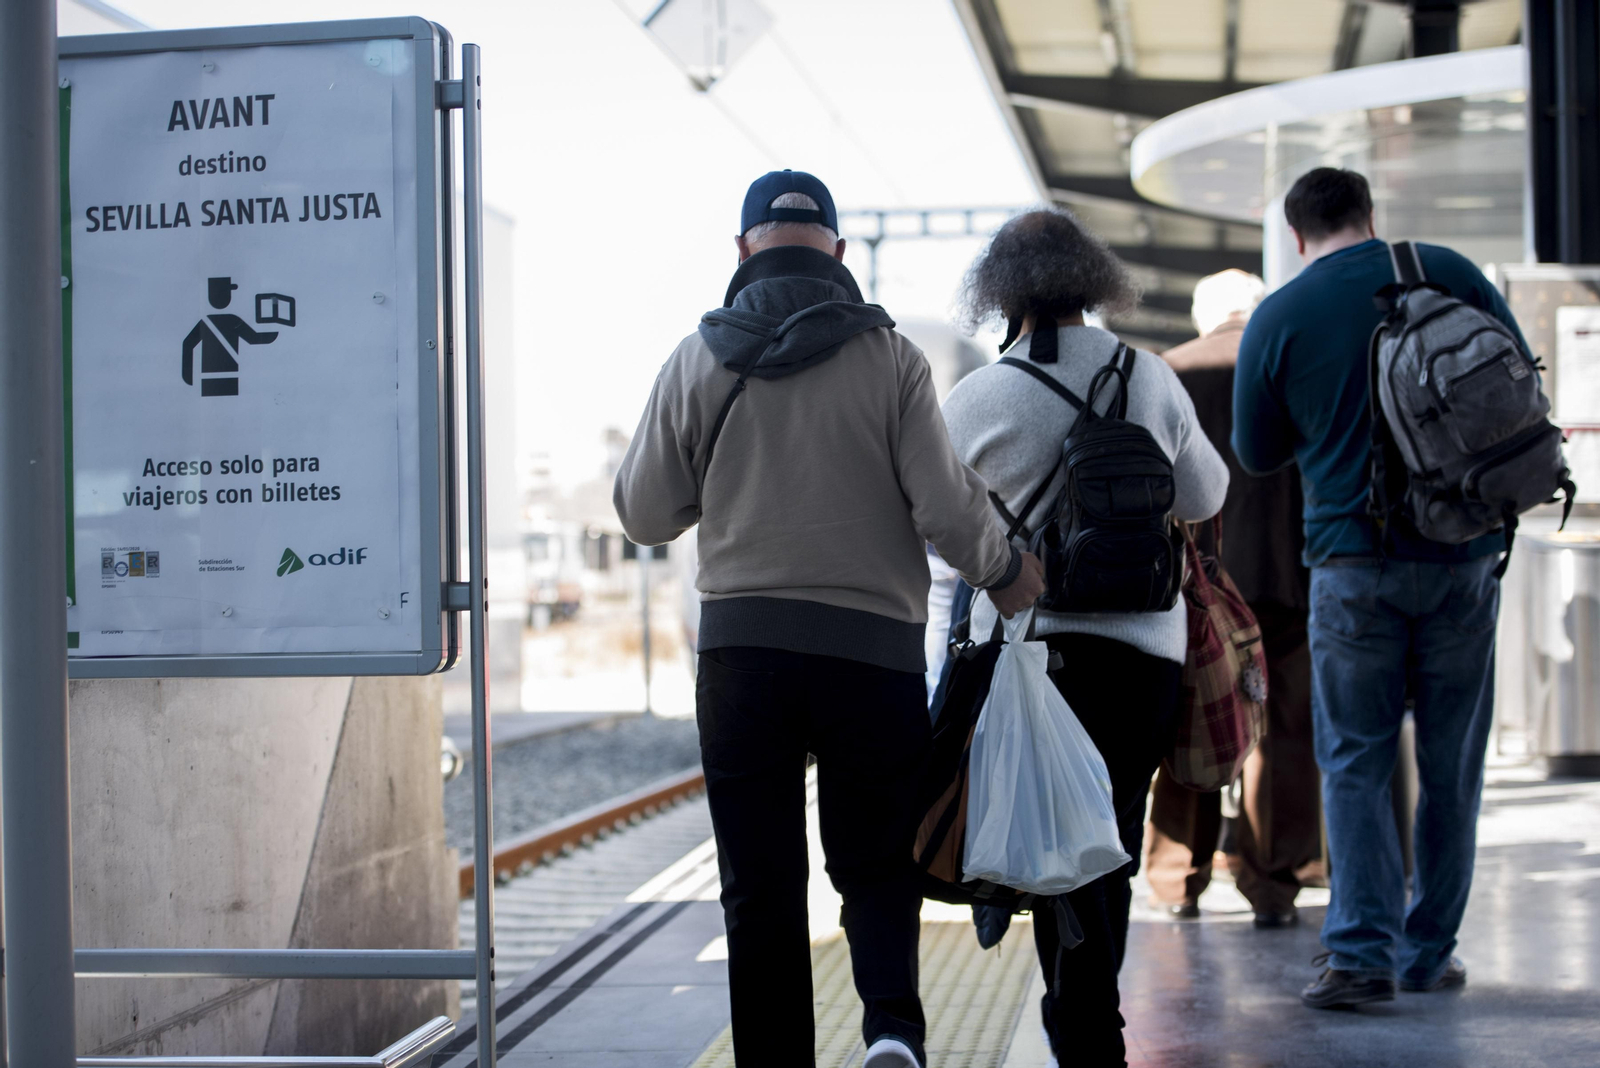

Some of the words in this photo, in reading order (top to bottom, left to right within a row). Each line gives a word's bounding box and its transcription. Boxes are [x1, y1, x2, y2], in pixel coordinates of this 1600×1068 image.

[167, 94, 275, 132] AVANT
[178, 150, 267, 176] destino
[85, 202, 192, 232] SEVILLA
[201, 197, 290, 226] SANTA
[299, 192, 382, 222] JUSTA
[142, 457, 212, 477] Acceso
[220, 455, 264, 475] solo
[272, 456, 320, 478] para
[123, 485, 208, 511] viajeros
[216, 488, 252, 504] con
[262, 482, 341, 502] billetes
[308, 547, 368, 566] adif
